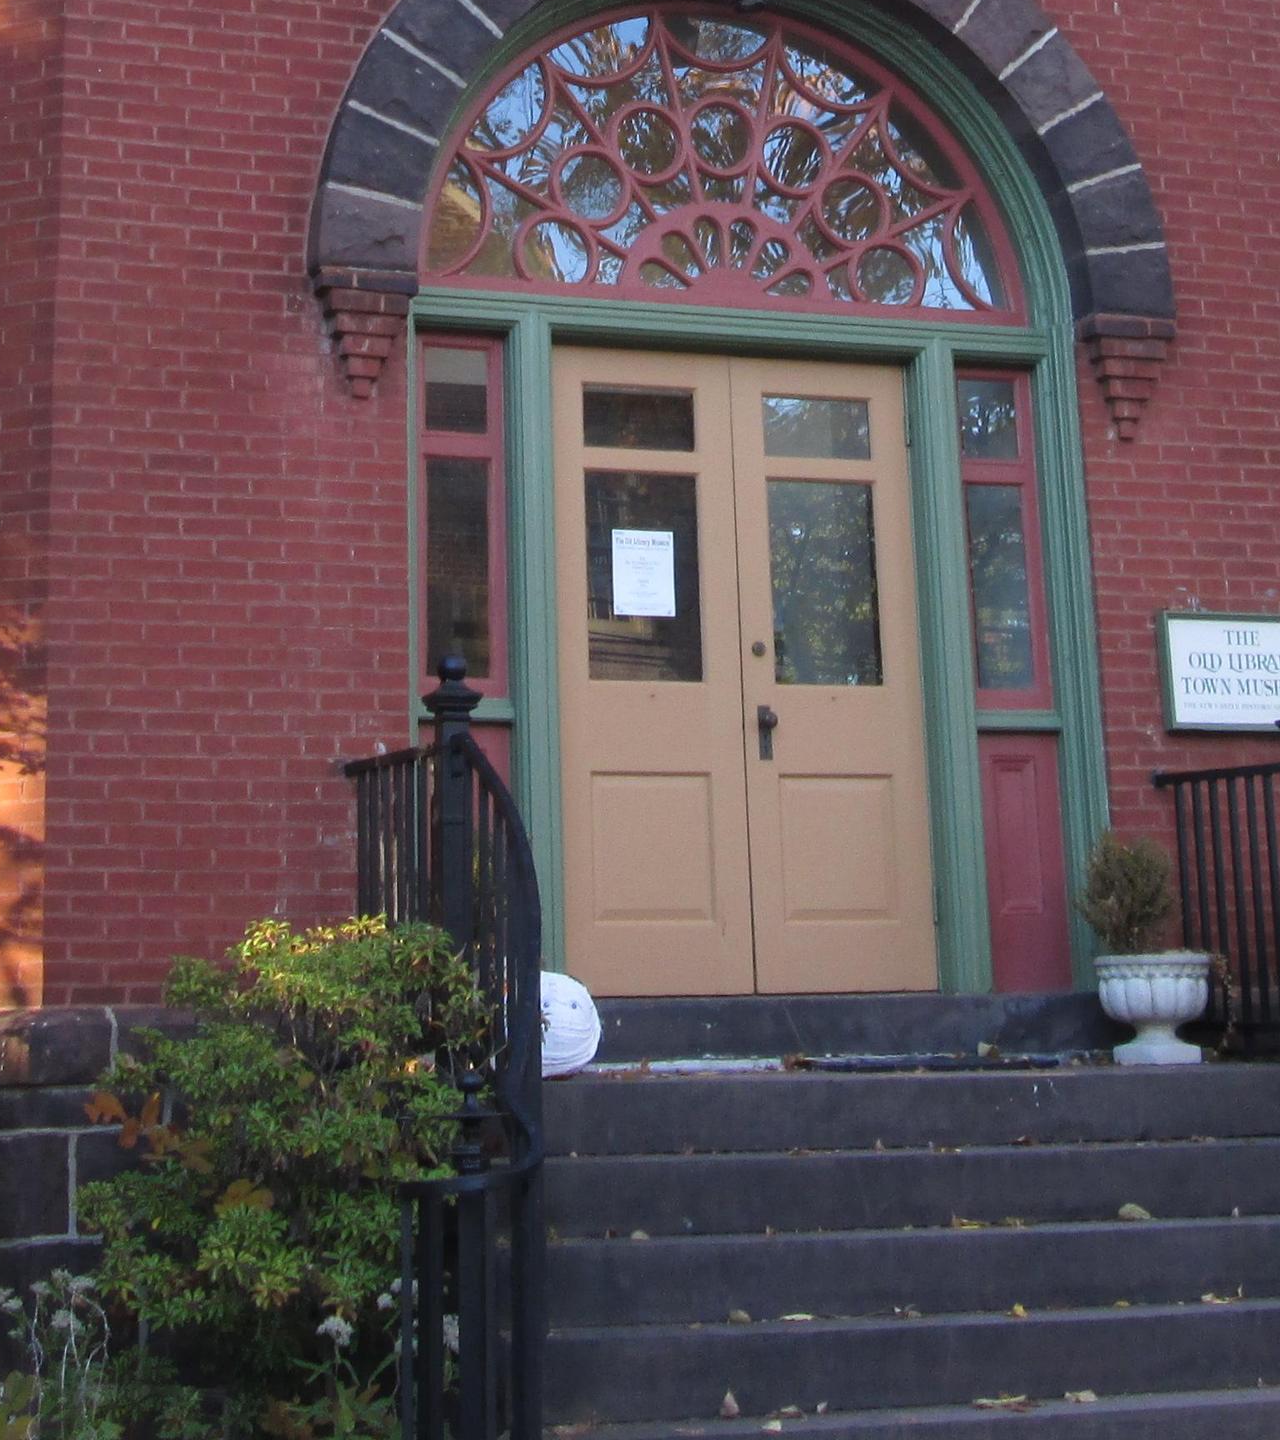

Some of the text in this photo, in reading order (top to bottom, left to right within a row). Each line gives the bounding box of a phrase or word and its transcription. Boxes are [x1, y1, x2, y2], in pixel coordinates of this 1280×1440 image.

[1223, 629, 1260, 647] THE
[1188, 651, 1222, 672] OLD
[1181, 676, 1232, 696] TOWN
